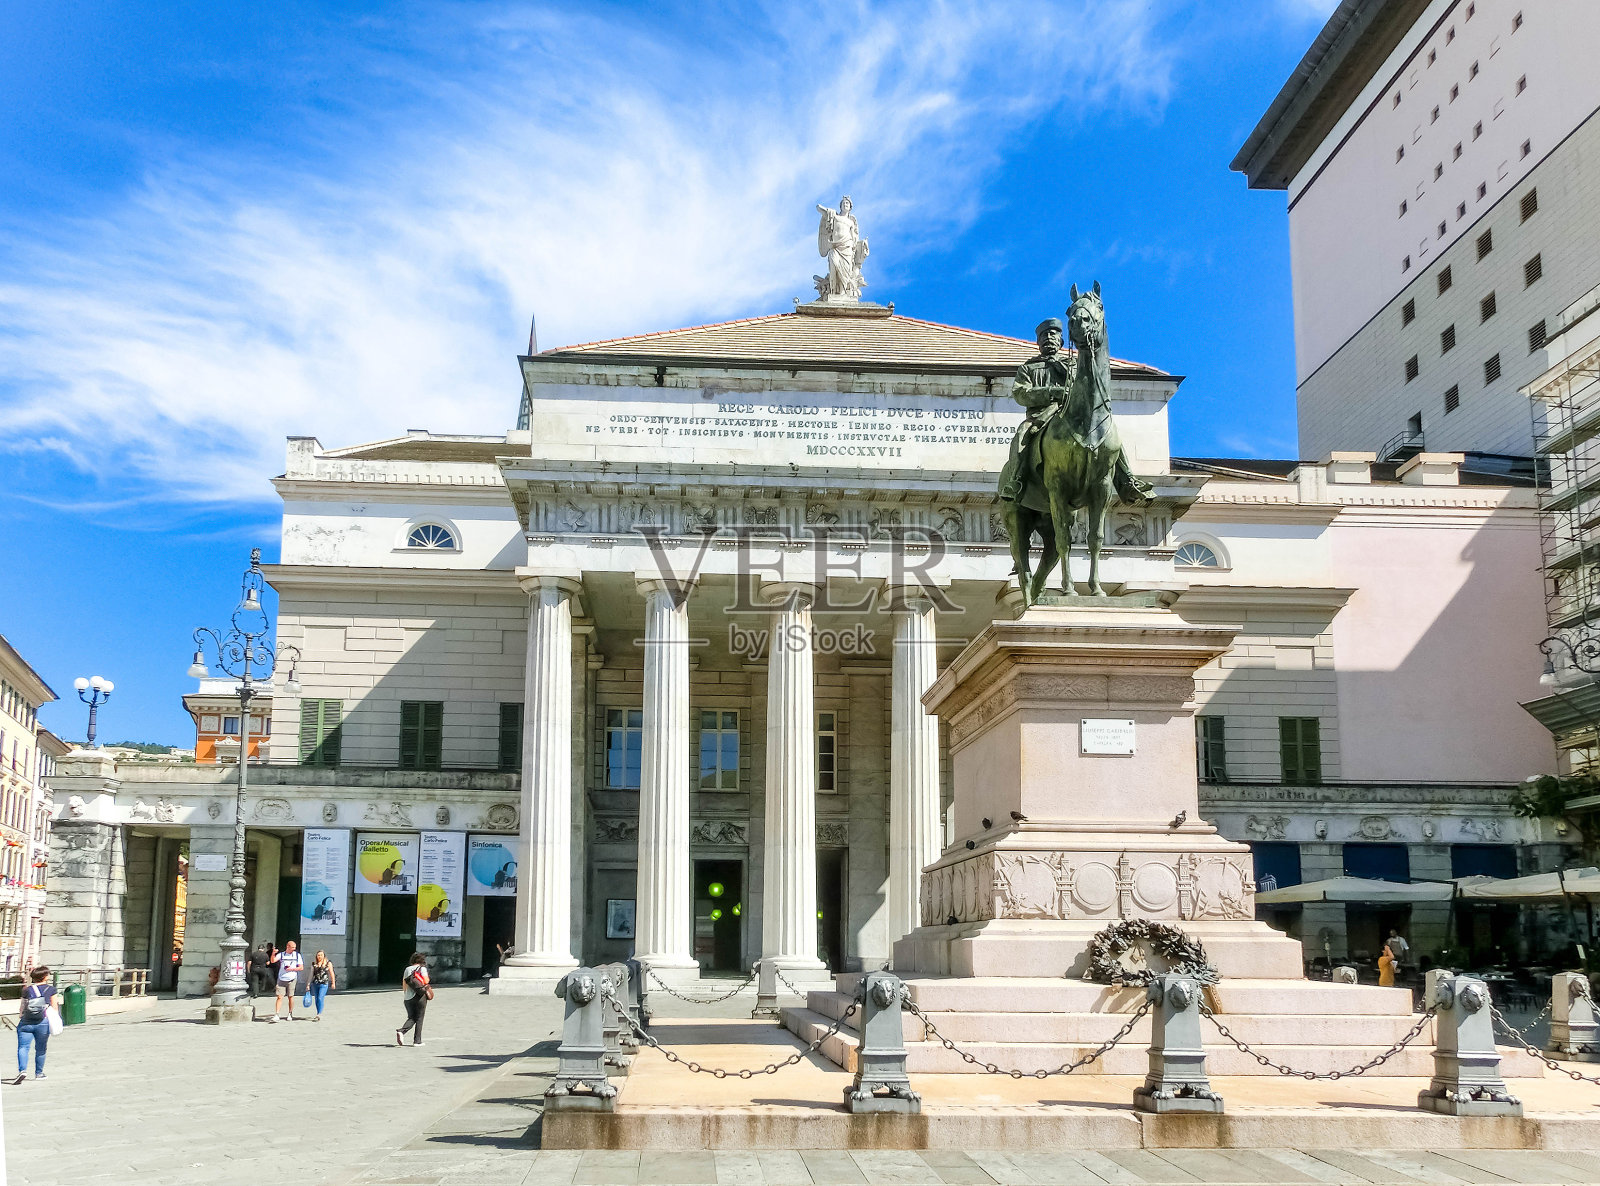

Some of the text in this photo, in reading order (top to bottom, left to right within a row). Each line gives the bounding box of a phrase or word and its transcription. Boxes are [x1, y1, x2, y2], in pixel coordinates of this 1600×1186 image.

[718, 403, 985, 420] REGE CAROLO FELICI DVCE NOSTRO
[609, 415, 638, 423] ORDO
[643, 416, 706, 425] GENVENSIS
[714, 418, 779, 428] SATAGENTE
[788, 420, 839, 429] HECTORE
[903, 423, 936, 432] REGIO
[585, 425, 601, 433] NE
[609, 426, 638, 434] VRBI
[648, 427, 670, 435] TOT
[678, 428, 744, 438] INSIGNIBVS
[753, 431, 829, 440] MONVMENTIS
[837, 433, 906, 442] INSTRVCTAE
[915, 435, 977, 444] THEATRVM
